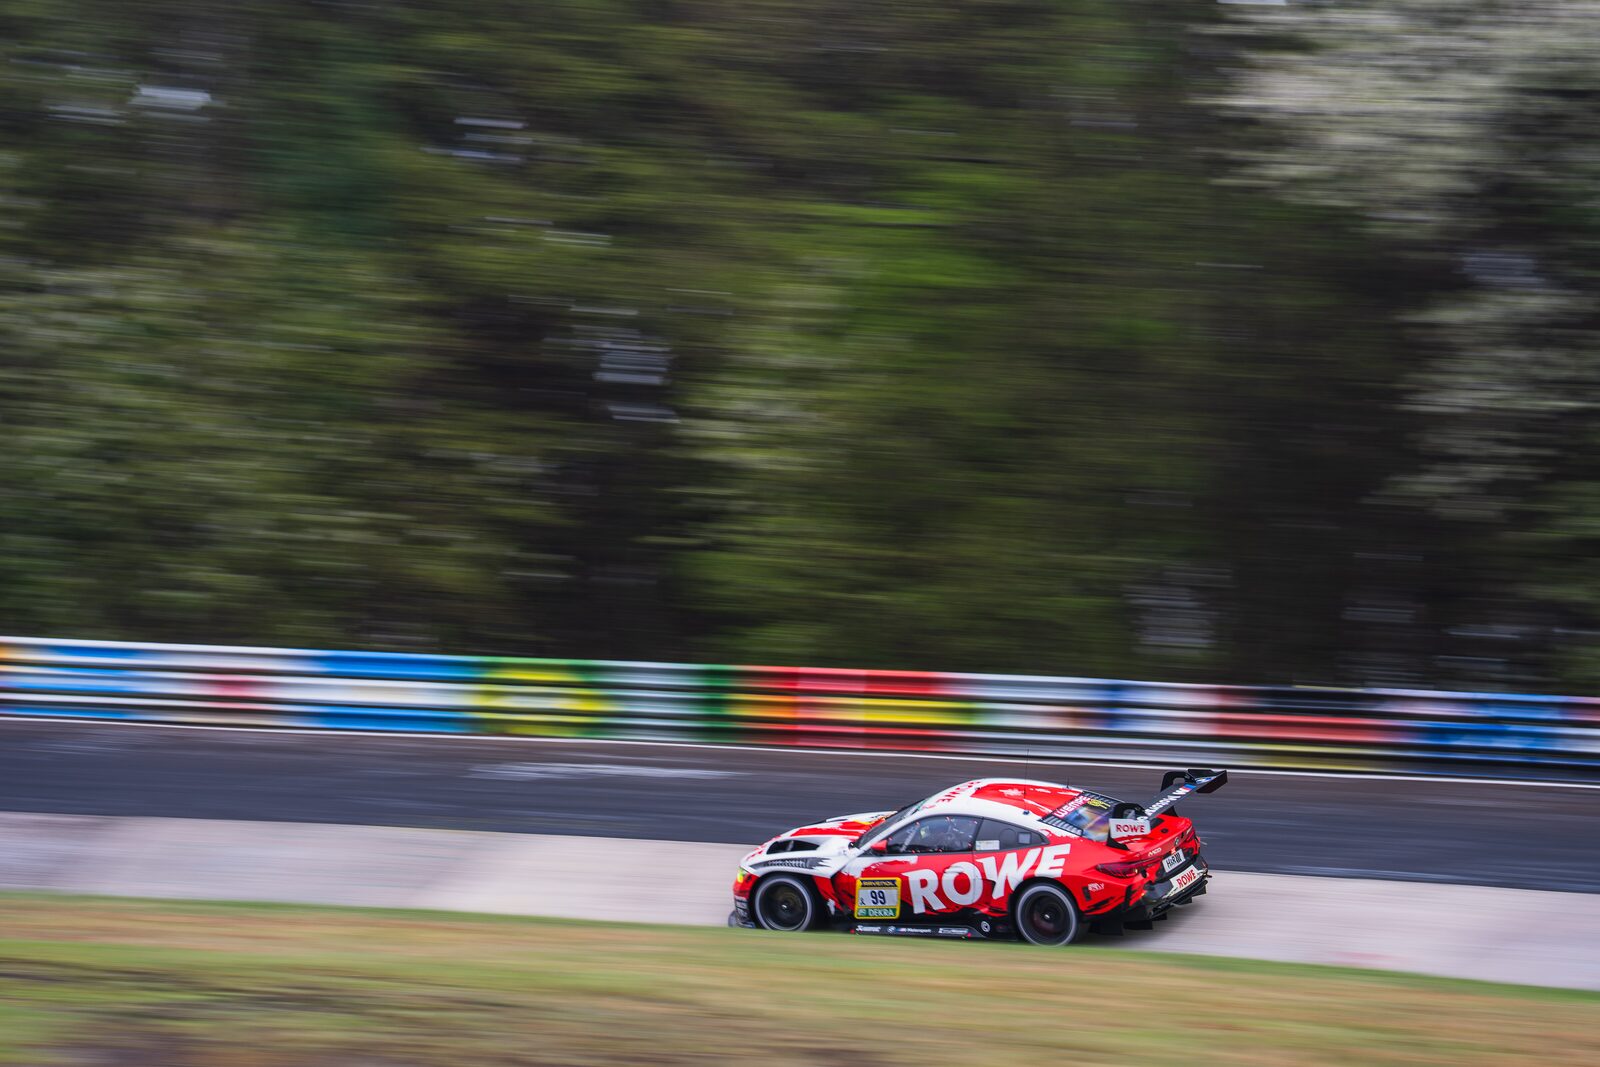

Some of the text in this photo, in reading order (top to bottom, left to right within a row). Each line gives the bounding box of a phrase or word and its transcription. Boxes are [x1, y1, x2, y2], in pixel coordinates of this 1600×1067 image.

[1115, 824, 1145, 833] ROWE
[901, 843, 1071, 914] ROWE
[1176, 869, 1196, 889] ROWE
[870, 890, 886, 905] 99
[868, 908, 895, 917] DEKRA
